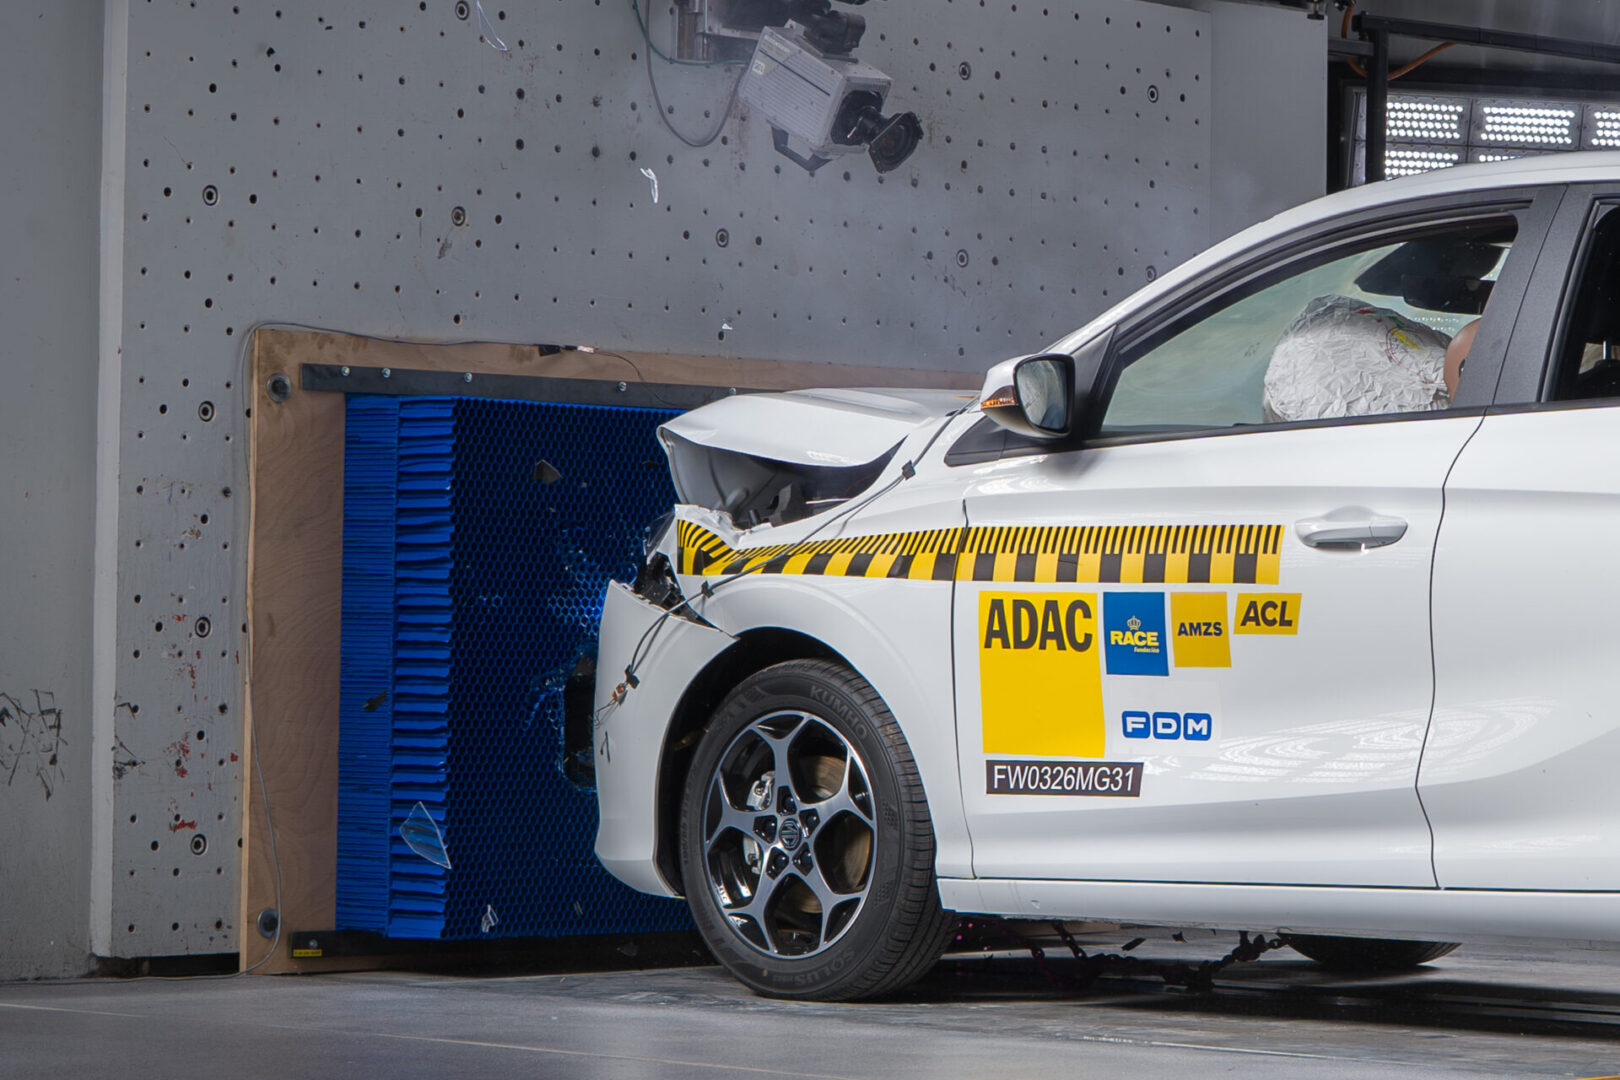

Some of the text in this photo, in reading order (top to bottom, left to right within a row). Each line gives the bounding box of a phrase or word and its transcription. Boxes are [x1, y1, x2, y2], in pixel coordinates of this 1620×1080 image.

[984, 598, 1093, 652] ADAC
[1240, 600, 1293, 627] ACL
[1110, 630, 1159, 647] RACE
[1177, 621, 1223, 637] AMZS
[809, 684, 867, 739] KUMHO
[1125, 715, 1209, 737] FDM
[993, 765, 1135, 792] FW0326MG31
